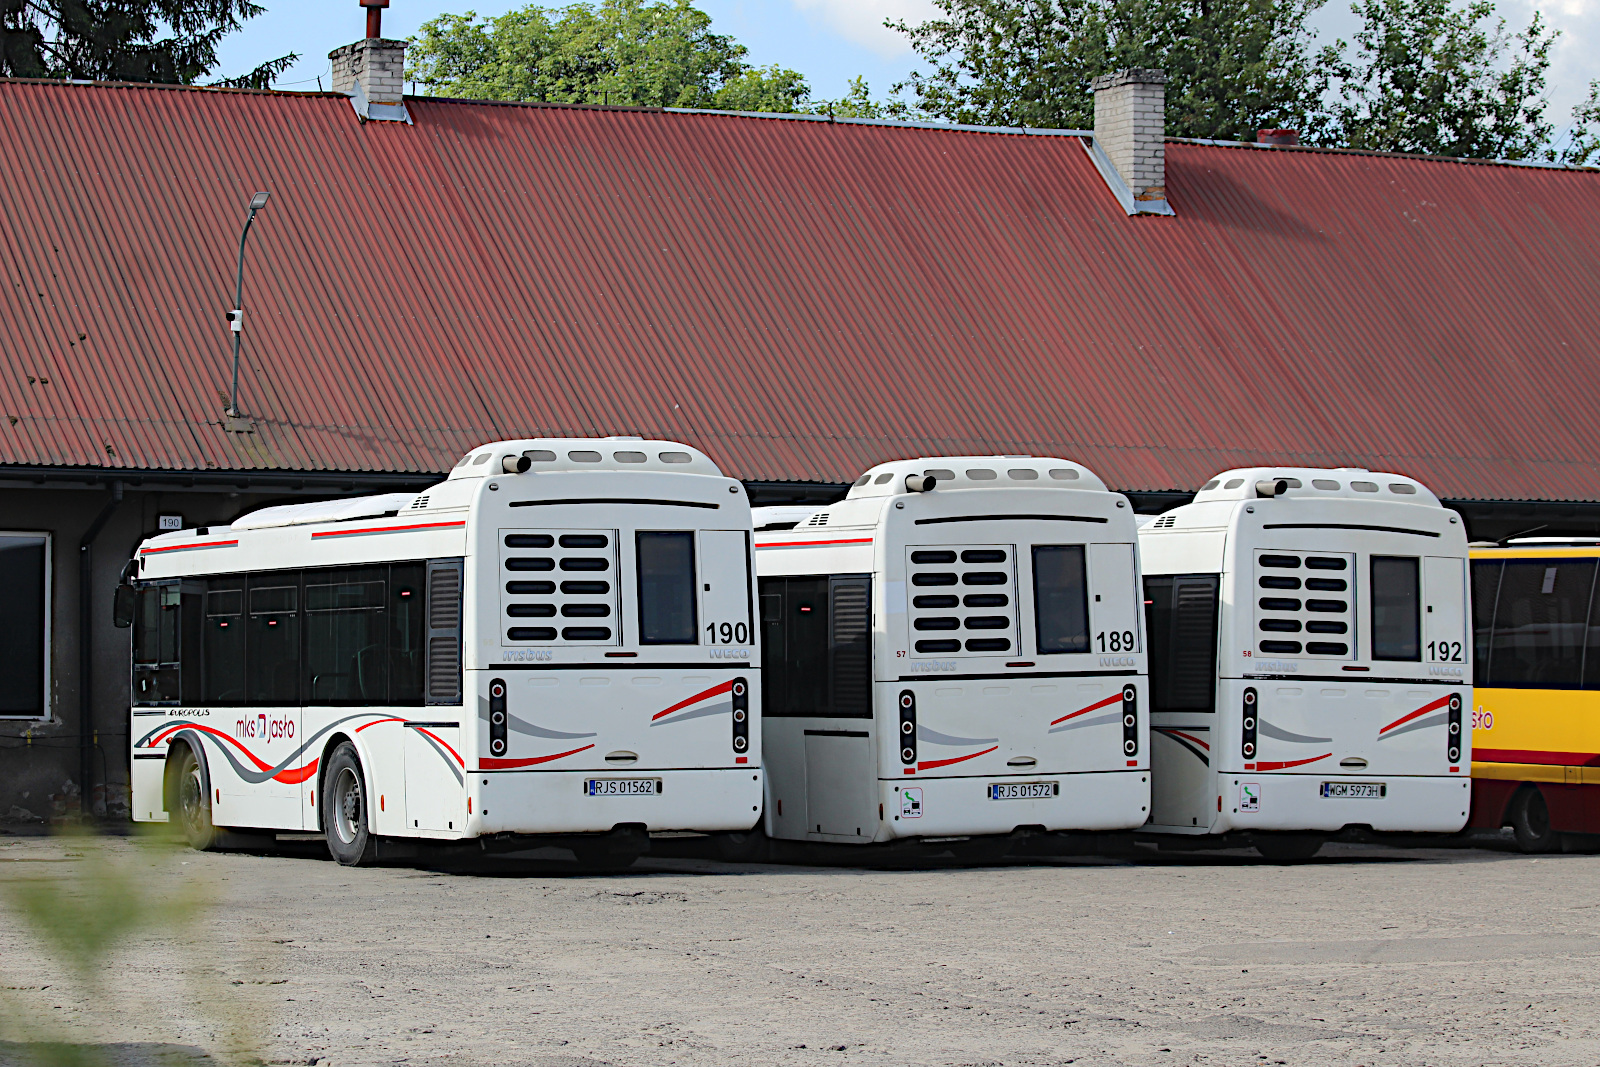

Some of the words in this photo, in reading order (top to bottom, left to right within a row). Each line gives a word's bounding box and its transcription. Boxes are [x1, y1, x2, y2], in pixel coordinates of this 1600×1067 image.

[163, 518, 180, 528] 190
[706, 622, 748, 644] 190
[1096, 631, 1134, 653] 189
[503, 649, 553, 662] irisbus
[710, 649, 750, 659] IVECO
[896, 650, 906, 658] 57
[1242, 650, 1252, 658] 58
[1427, 641, 1462, 662] 192
[911, 660, 957, 672] irisbus
[1100, 657, 1136, 666] IVECO
[1429, 666, 1463, 676] IVECO
[168, 709, 210, 717] EUROPOLIS
[236, 715, 255, 738] mks
[266, 715, 294, 744] jasło
[595, 781, 617, 794] RJS
[619, 781, 652, 794] 01562
[998, 785, 1017, 797] RJS
[1020, 785, 1050, 797] 01572
[1329, 784, 1348, 796] WGM
[1350, 784, 1378, 796] 5973H
